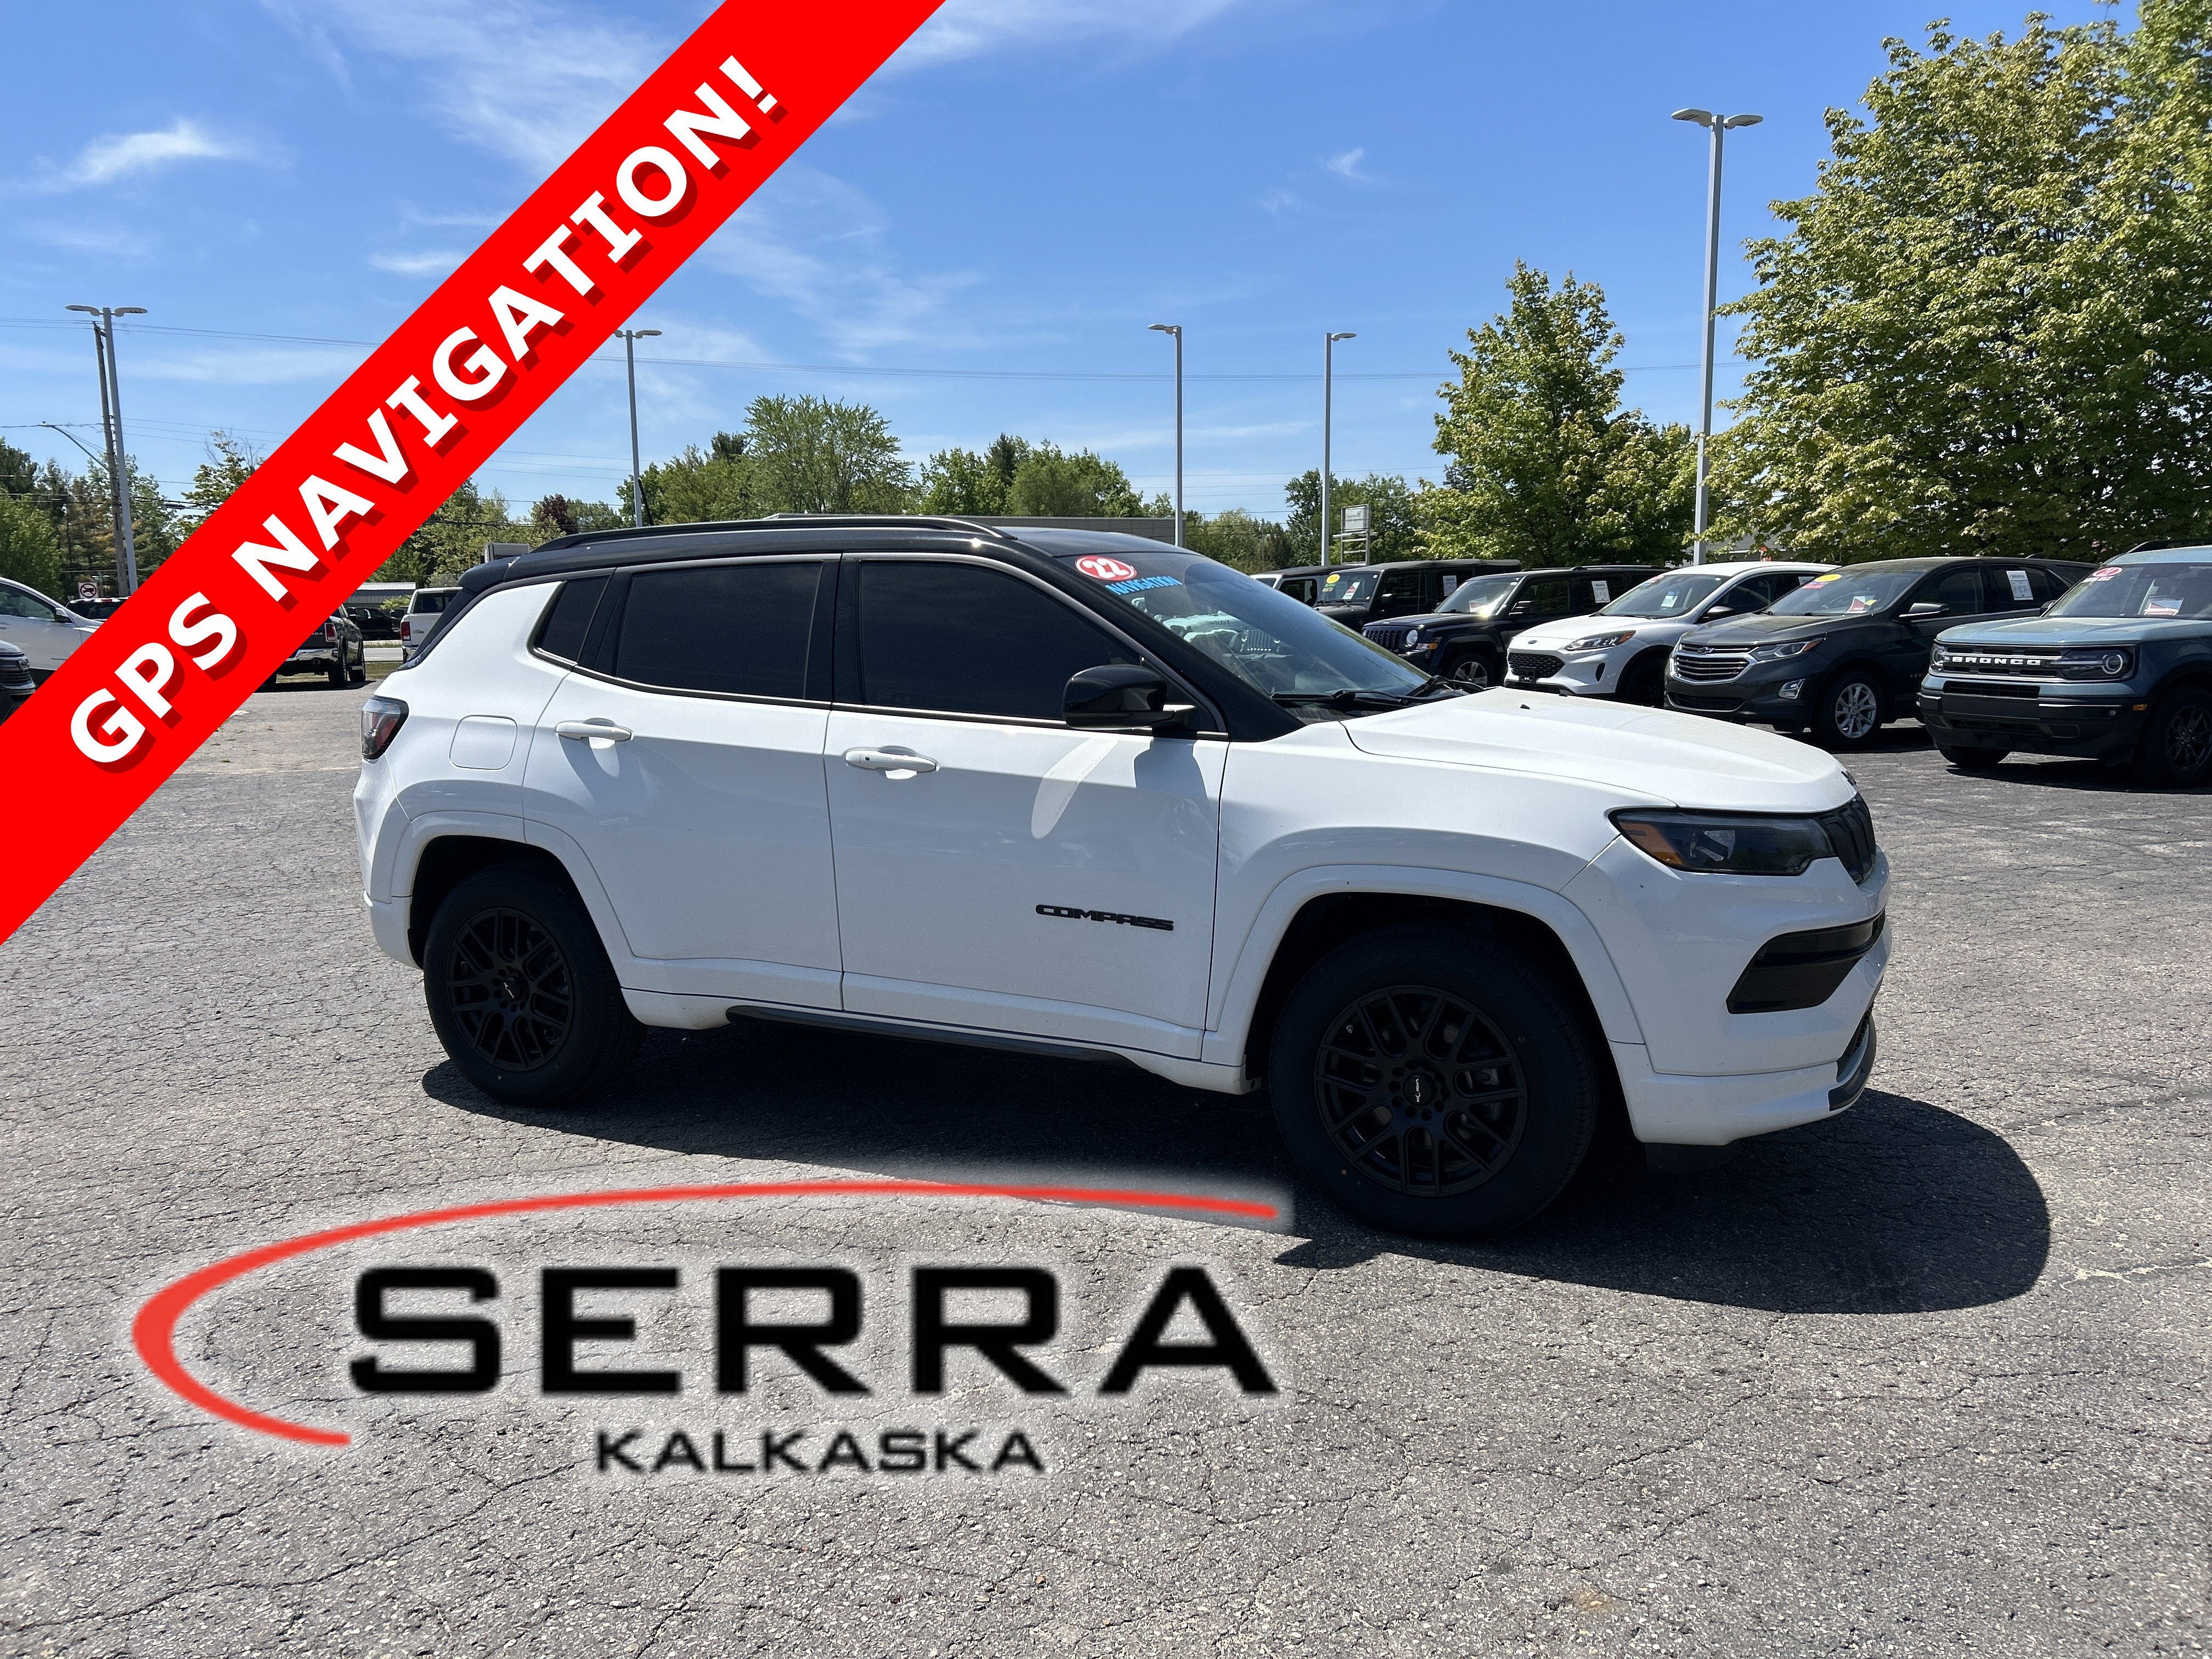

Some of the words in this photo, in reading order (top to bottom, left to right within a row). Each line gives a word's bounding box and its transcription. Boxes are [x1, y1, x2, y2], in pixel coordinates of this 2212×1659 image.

[1081, 557, 1131, 579] 22
[1105, 576, 1183, 595] NAVIGATION
[1952, 656, 2041, 665] BRONCO
[1036, 904, 1173, 931] COMPASS
